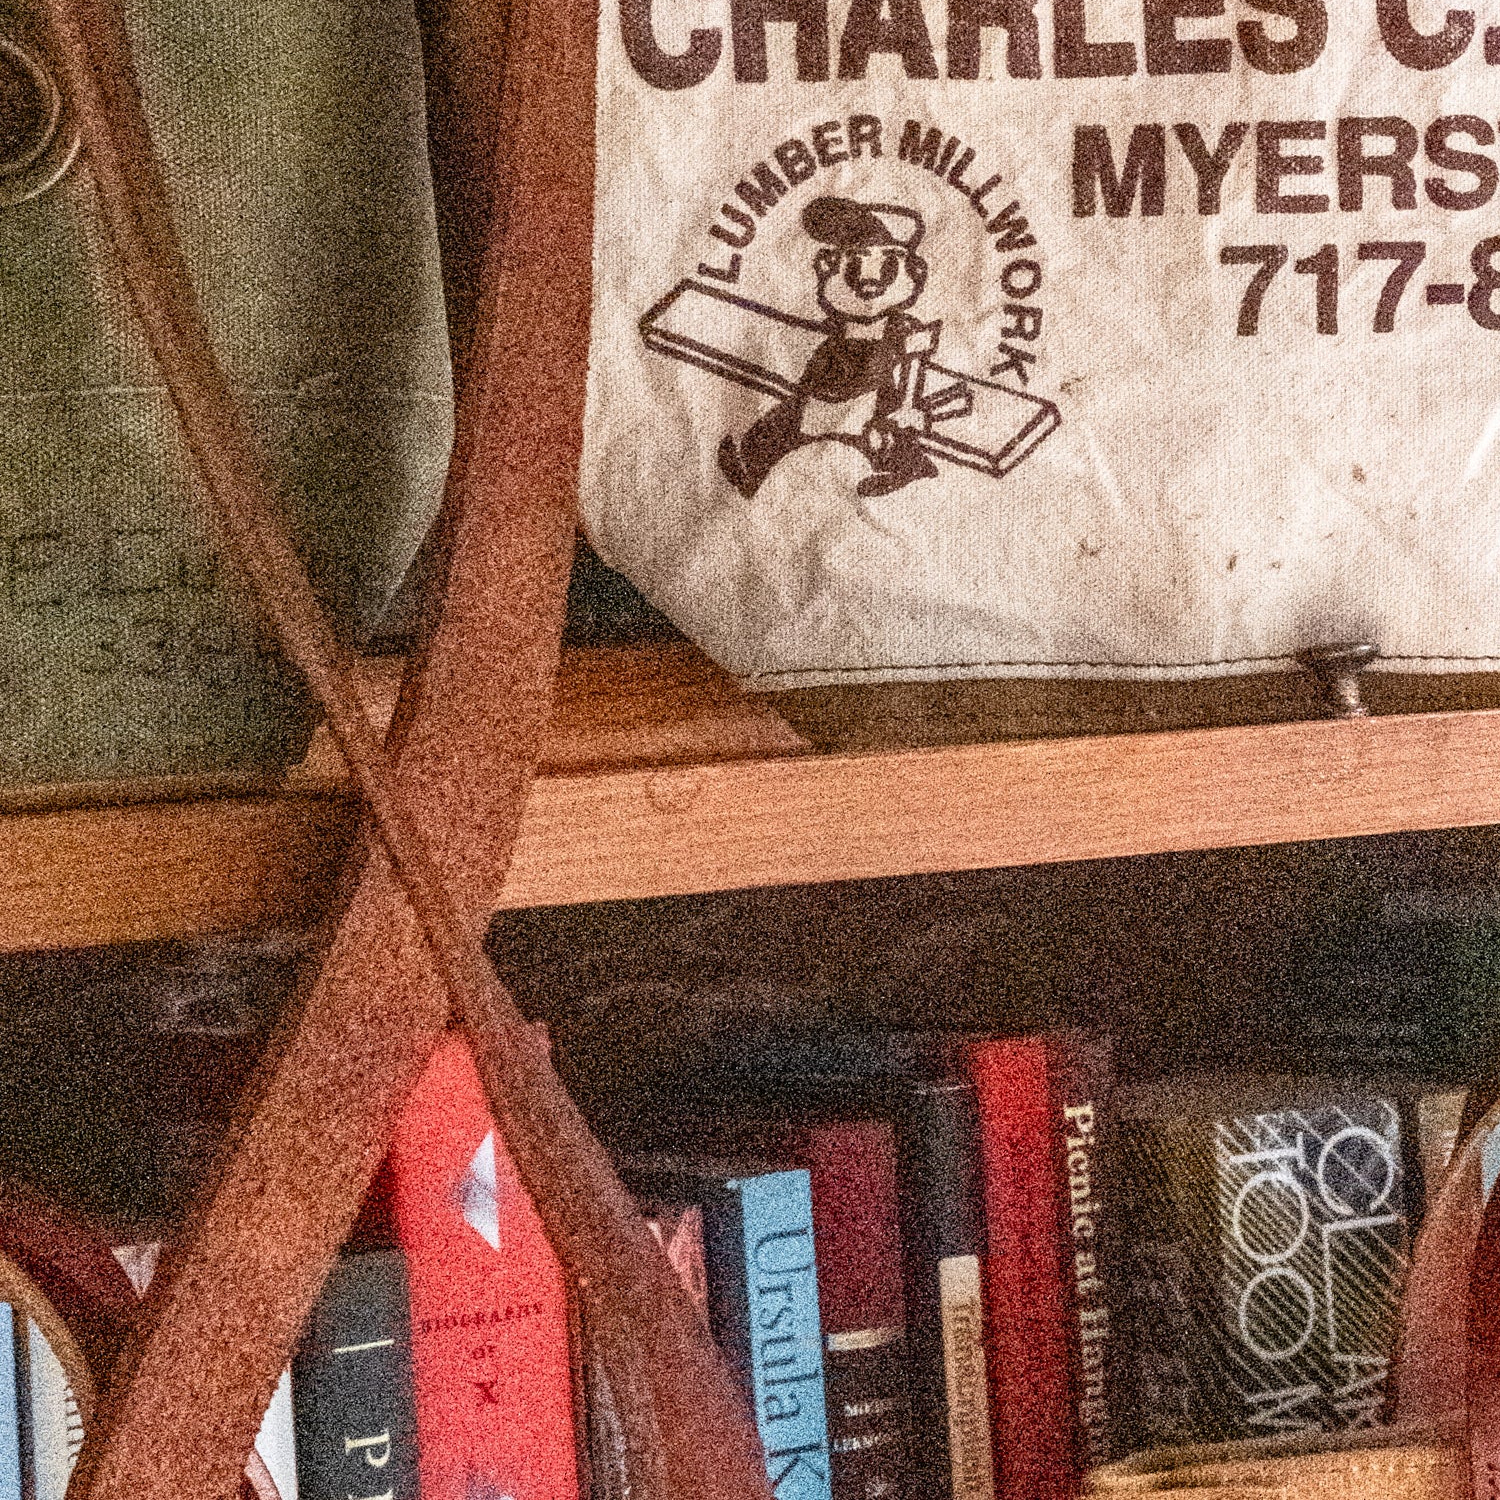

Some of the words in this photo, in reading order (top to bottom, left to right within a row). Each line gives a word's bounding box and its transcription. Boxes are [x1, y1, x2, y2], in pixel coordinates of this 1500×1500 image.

[698, 113, 883, 284] LUMBER
[899, 118, 1044, 385] MILLWORK
[1063, 1100, 1101, 1239] Picnic
[420, 1301, 543, 1334] BIOGRAPHY
[1073, 1251, 1104, 1294] at
[753, 1226, 819, 1424] Ursula
[472, 1378, 500, 1408] X
